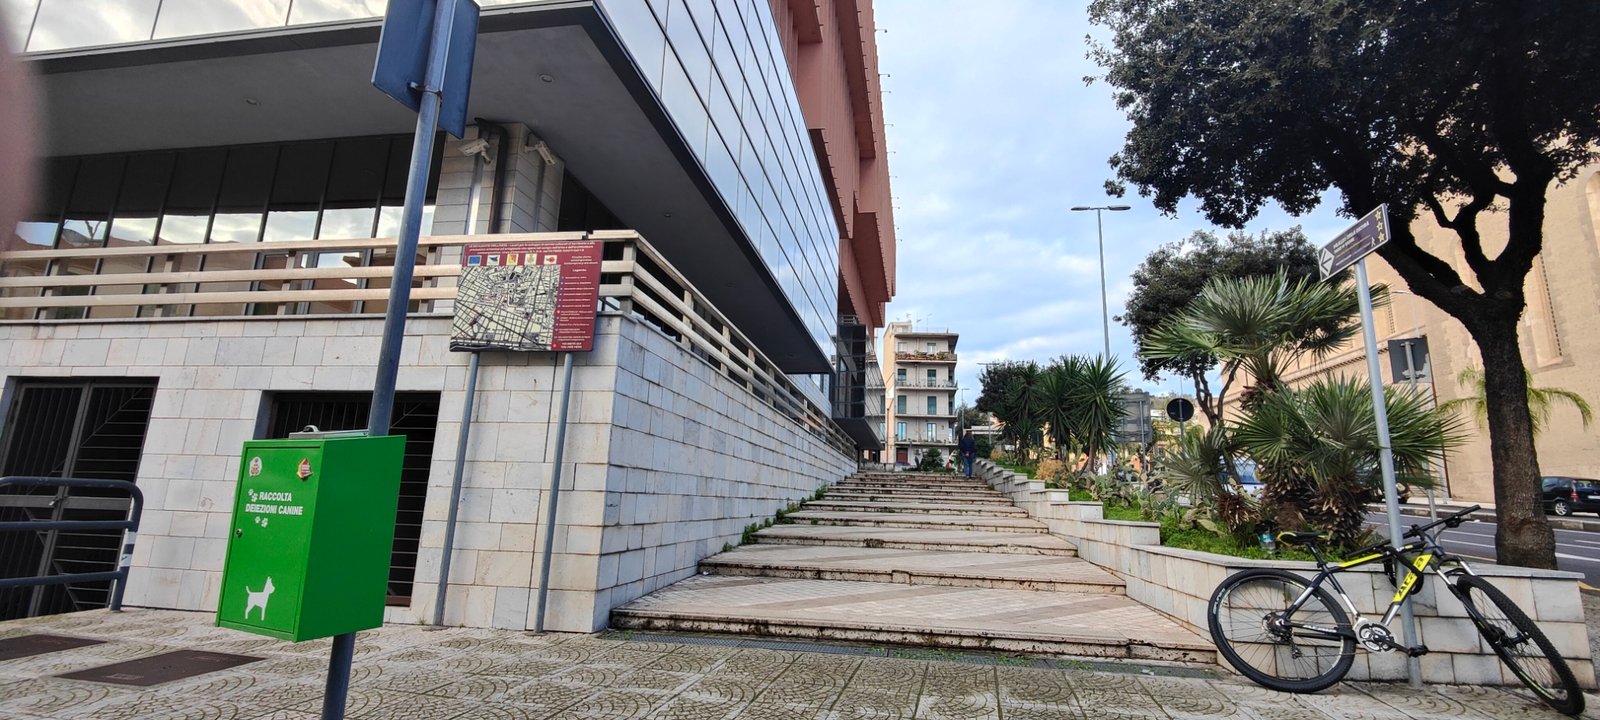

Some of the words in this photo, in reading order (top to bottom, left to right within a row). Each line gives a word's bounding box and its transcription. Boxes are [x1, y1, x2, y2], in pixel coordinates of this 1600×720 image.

[259, 492, 292, 501] RACCOLTA
[245, 504, 277, 513] DEIEZIONI
[279, 506, 303, 515] CANINE
